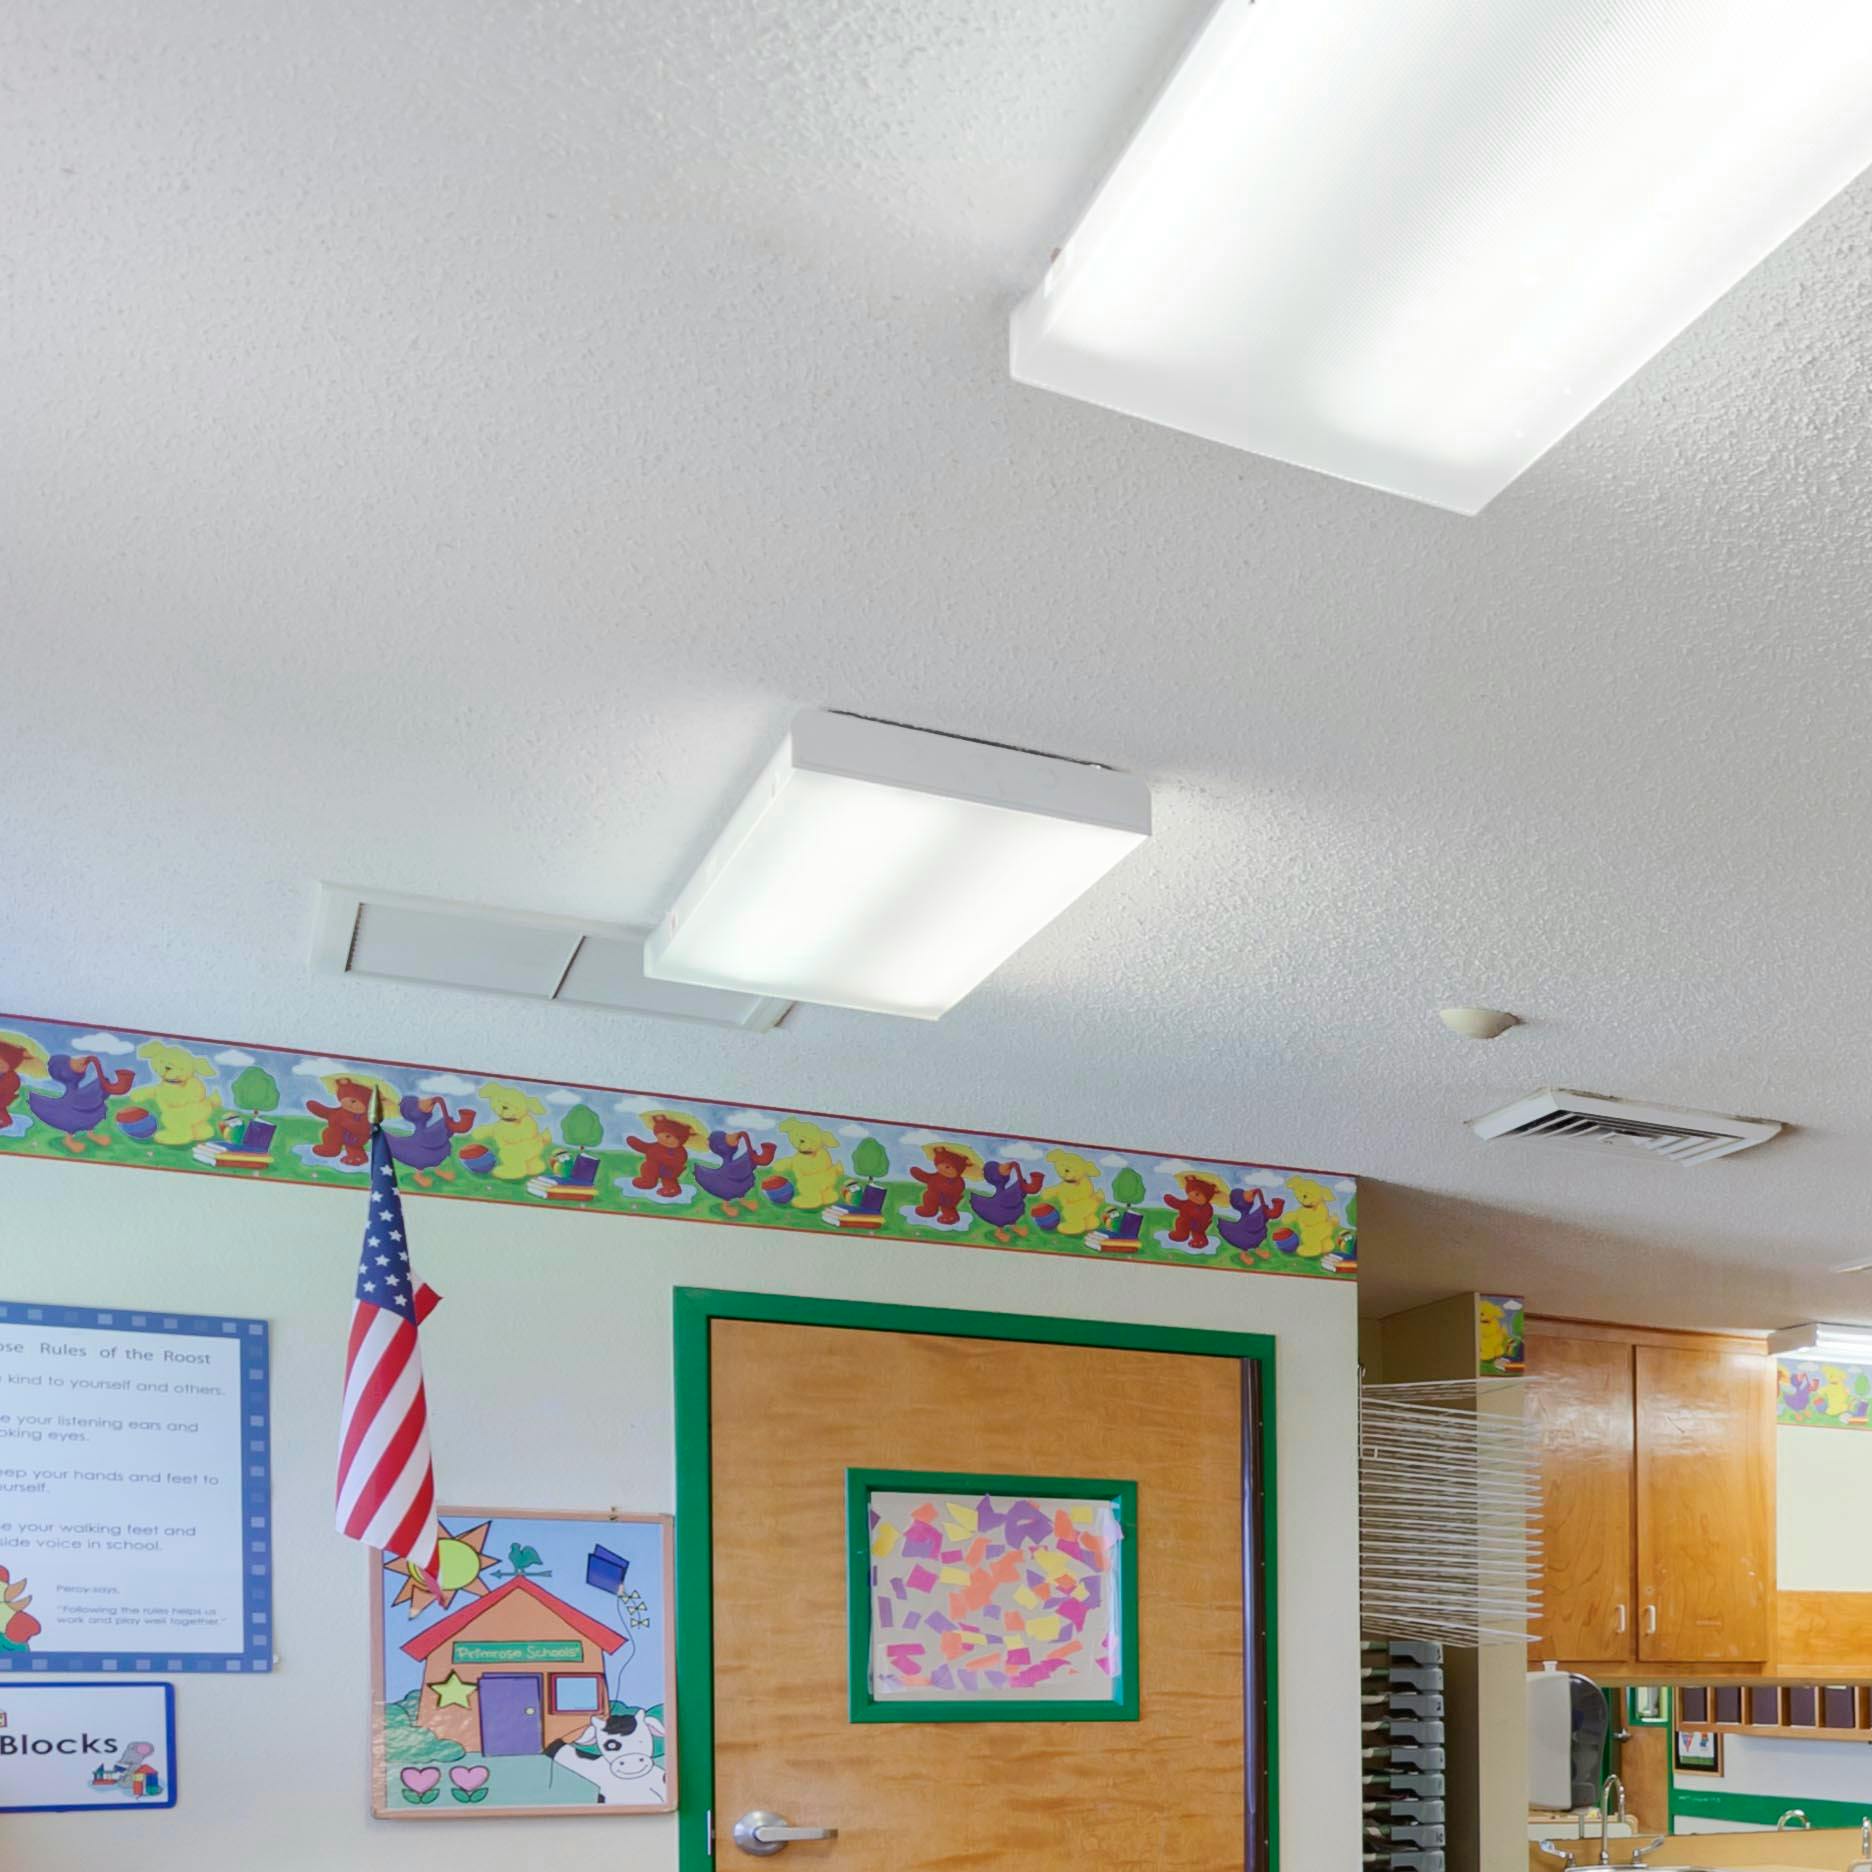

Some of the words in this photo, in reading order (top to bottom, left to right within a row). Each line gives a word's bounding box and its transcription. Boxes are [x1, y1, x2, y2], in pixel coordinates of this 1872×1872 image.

[40, 1342, 87, 1357] Rules
[99, 1346, 116, 1359] of
[125, 1348, 154, 1361] the
[163, 1350, 211, 1365] Roost
[8, 1373, 42, 1386] kind
[48, 1375, 65, 1386] to
[70, 1377, 131, 1392] yourself
[136, 1381, 168, 1393] and
[174, 1382, 226, 1396] others.
[17, 1415, 51, 1426] your
[57, 1416, 123, 1431] listening
[128, 1420, 161, 1431] ears
[166, 1421, 199, 1433] and
[47, 1431, 90, 1442] eyes.
[32, 1470, 68, 1481] your
[73, 1470, 124, 1483] hands
[128, 1473, 161, 1484] and
[167, 1473, 199, 1486] feet
[203, 1474, 220, 1487] to
[18, 1523, 53, 1534] your
[59, 1523, 122, 1537] walking
[127, 1524, 159, 1536] feet
[164, 1525, 197, 1537] and
[36, 1537, 82, 1550] voice
[88, 1538, 101, 1550] in
[106, 1540, 163, 1552] school.
[0, 1732, 119, 1756] Blocks
